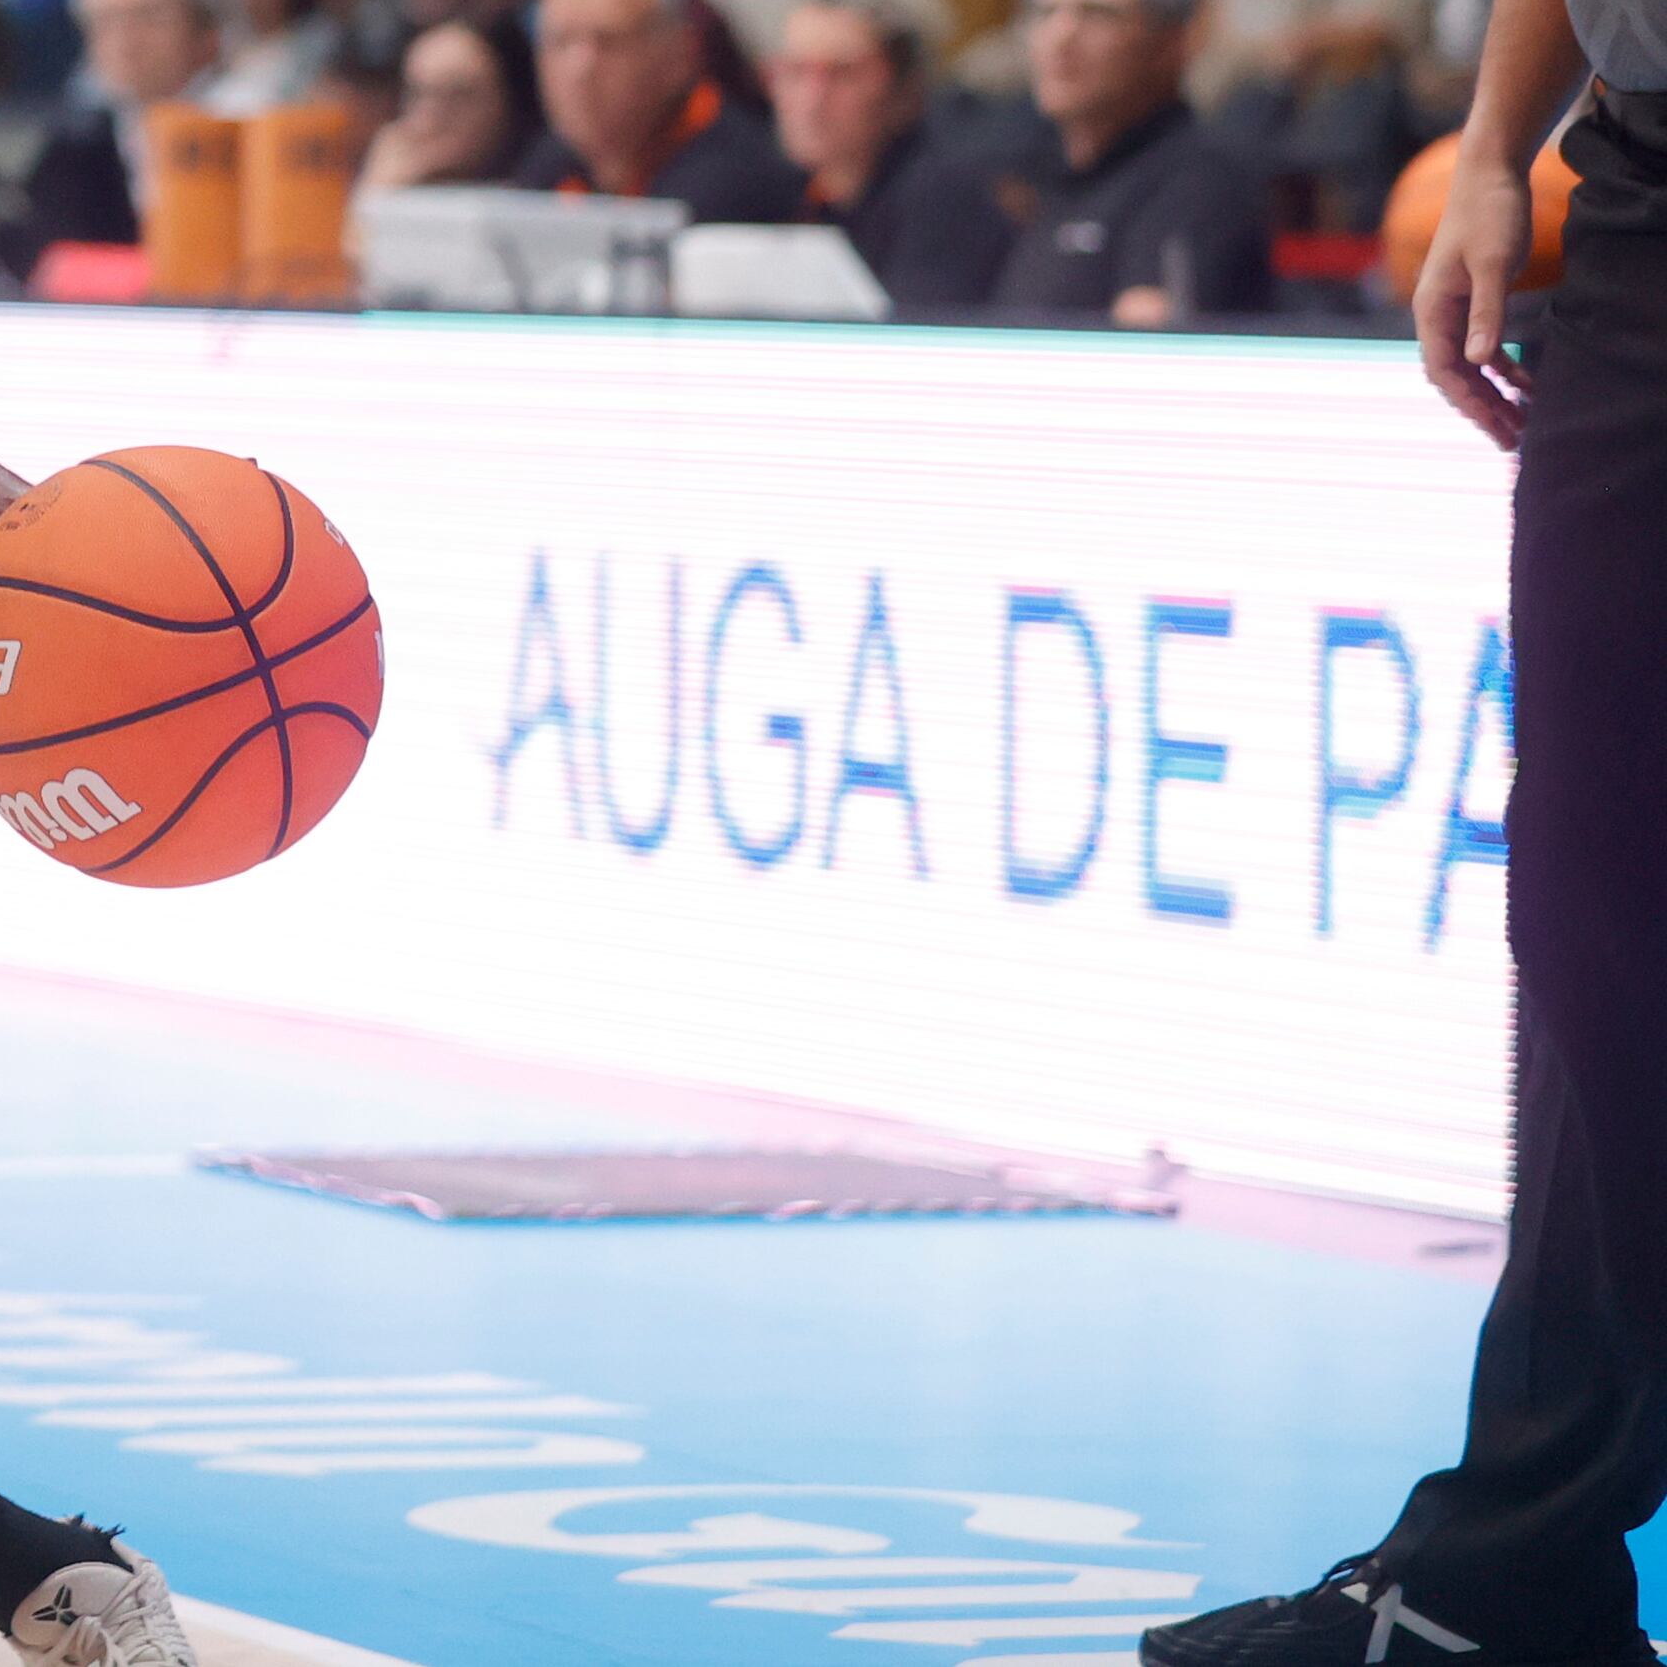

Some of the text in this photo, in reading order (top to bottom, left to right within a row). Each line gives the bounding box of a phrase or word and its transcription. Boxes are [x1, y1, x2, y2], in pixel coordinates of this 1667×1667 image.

[483, 546, 1515, 955] AUGA DE PA
